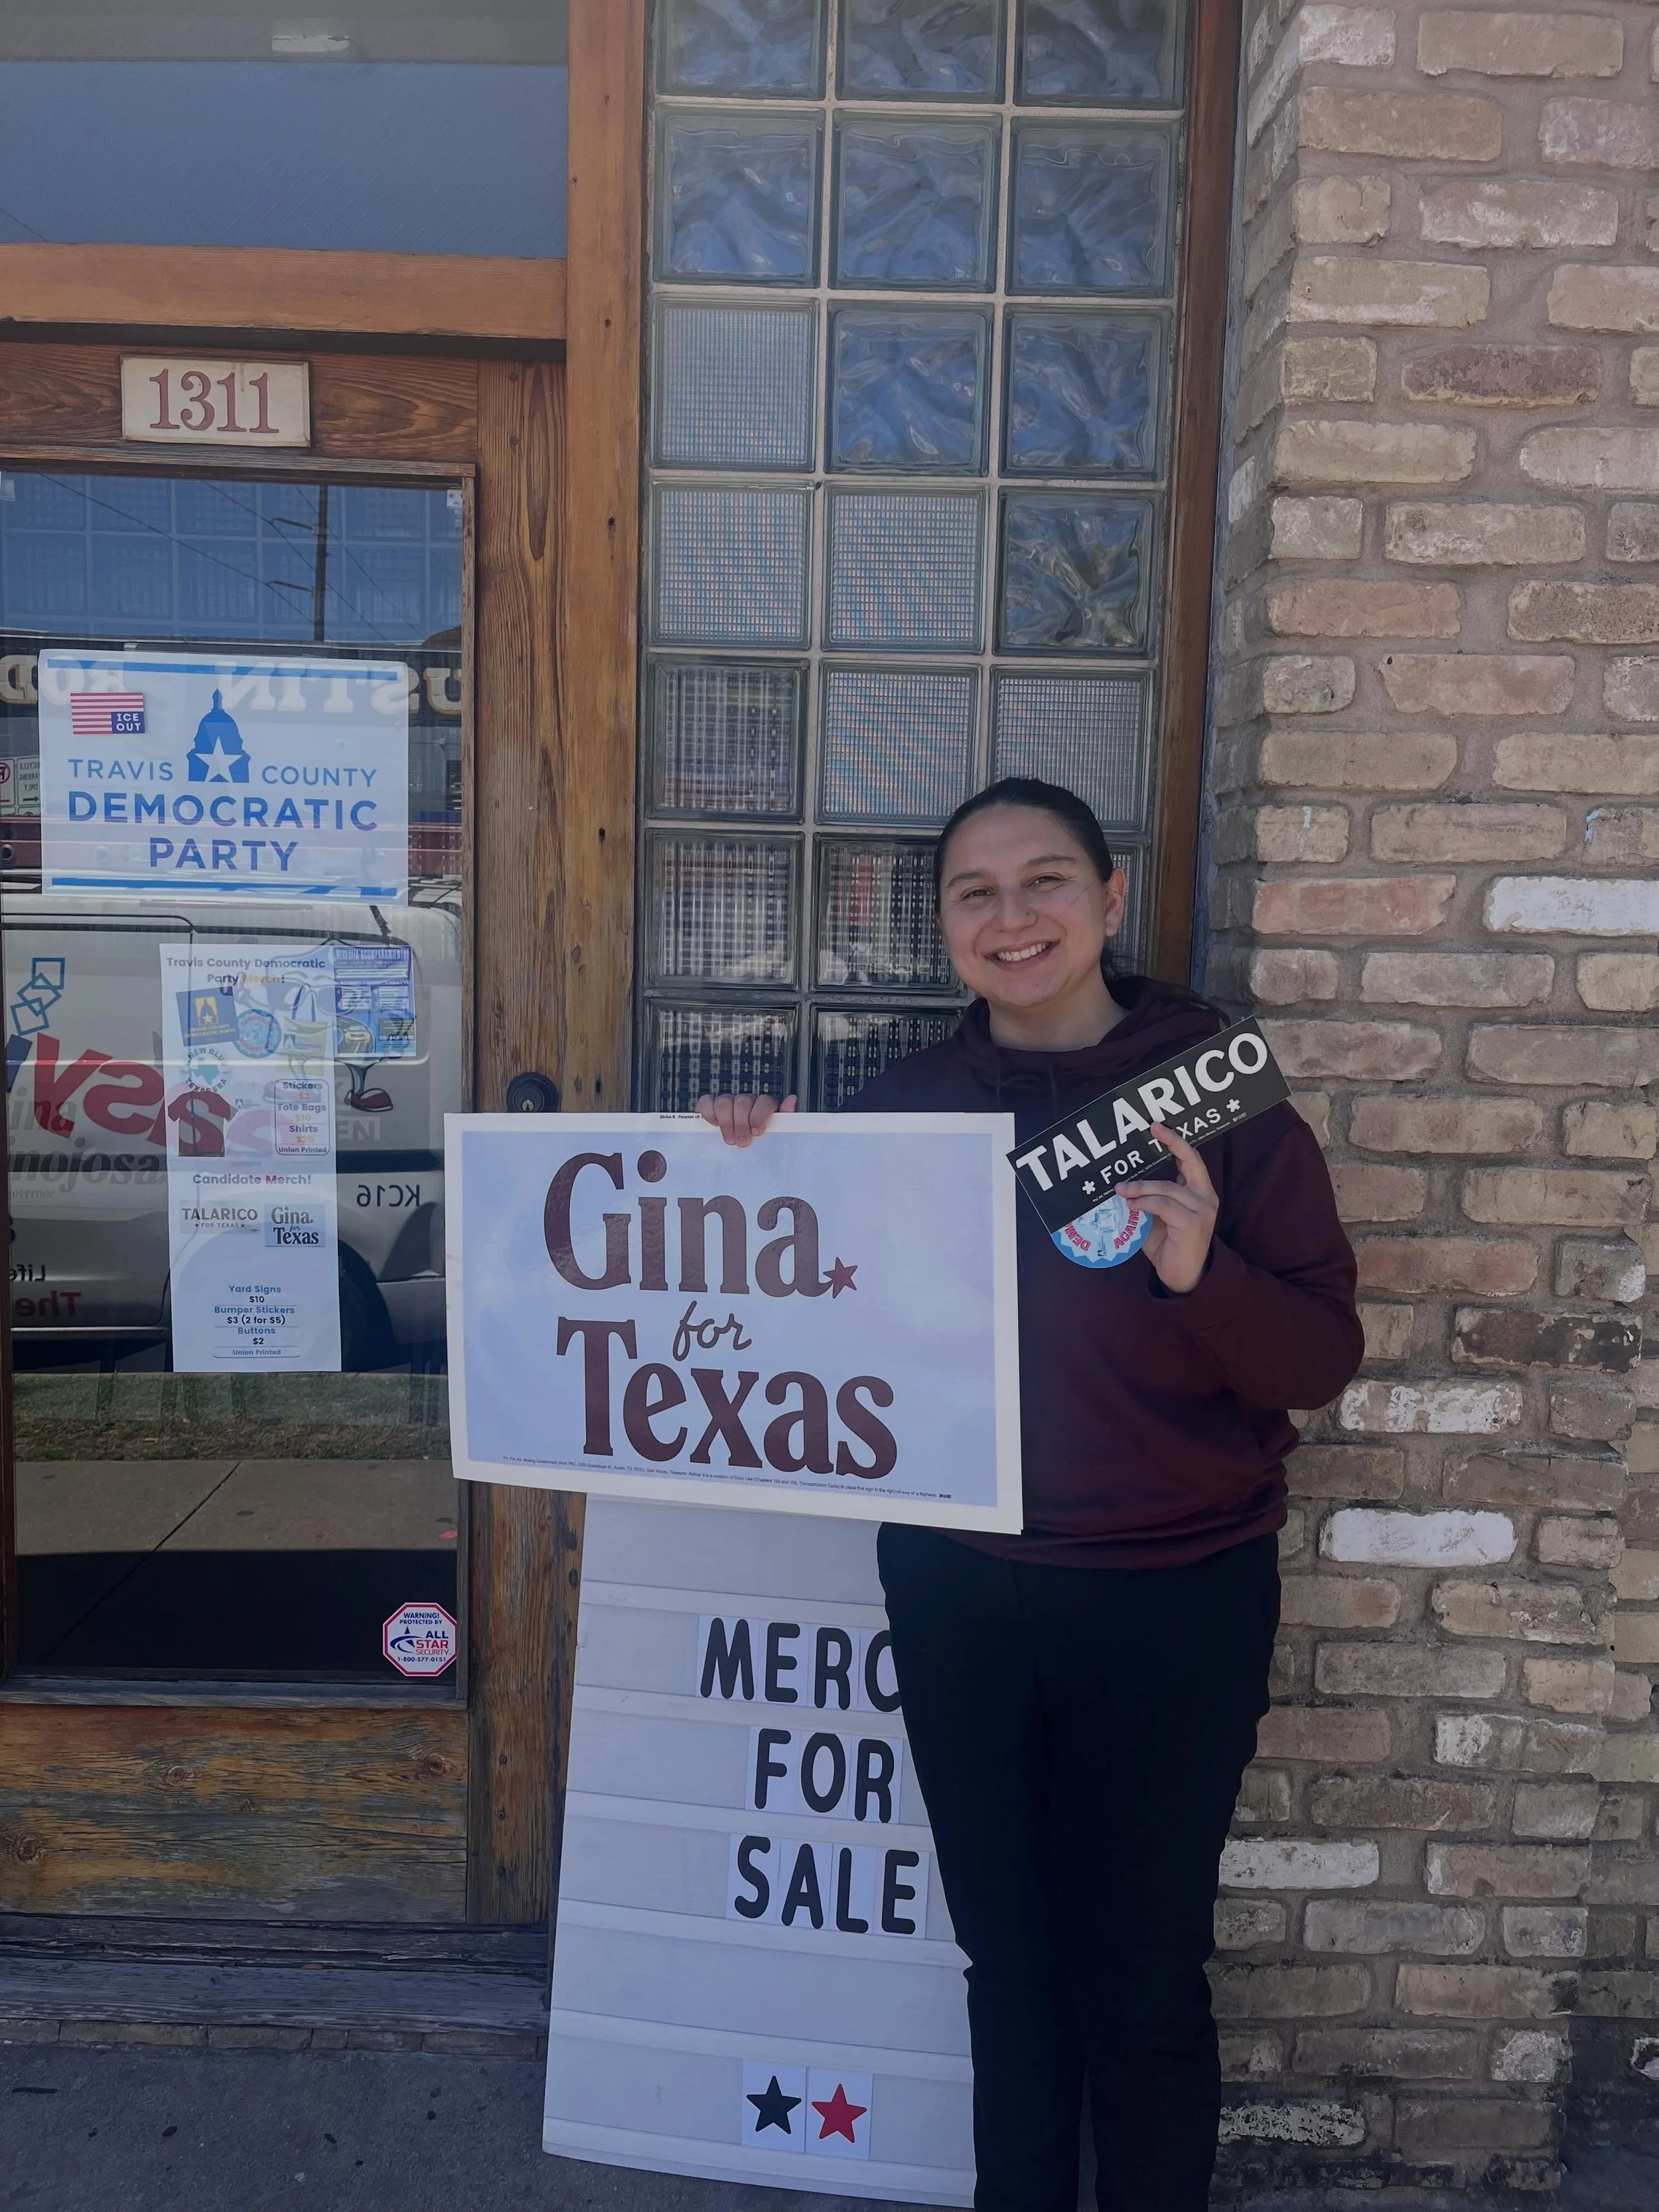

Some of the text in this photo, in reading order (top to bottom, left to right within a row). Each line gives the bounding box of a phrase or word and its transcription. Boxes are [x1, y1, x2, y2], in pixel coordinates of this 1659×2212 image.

[149, 369, 279, 433] 1311
[117, 713, 139, 722] ICE
[116, 723, 141, 731] OUT
[68, 759, 377, 787] TRAVIS COUNTY
[68, 790, 378, 831] DEMOCRATIC
[149, 837, 299, 872] PARTY
[167, 958, 326, 970] Travis County Democratic
[207, 974, 285, 986] Party Merch!
[187, 1047, 206, 1060] NEW
[212, 1078, 228, 1093] ERA
[301, 1103, 327, 1114] Bags
[1015, 1033, 1268, 1192] TALARICO
[296, 1135, 315, 1143] $25
[1100, 1108, 1222, 1185] FOR TXAS
[192, 1174, 312, 1185] Candidate Merch!
[182, 1206, 310, 1224] TALARICO Gina
[544, 1149, 834, 1299] Gina
[273, 1226, 319, 1245] Texas
[1064, 1222, 1092, 1252] DEM
[254, 1285, 282, 1295] Signs
[214, 1305, 295, 1316] Bumper Stickers
[226, 1315, 286, 1326] $3 (2 for $5)
[672, 1301, 753, 1361] for
[253, 1337, 264, 1345] $2
[556, 1316, 898, 1479] Texas
[425, 1631, 449, 1639] ALL
[416, 1639, 449, 1649] STAR
[755, 1728, 895, 1823] FOR
[735, 1835, 920, 1935] SALE
